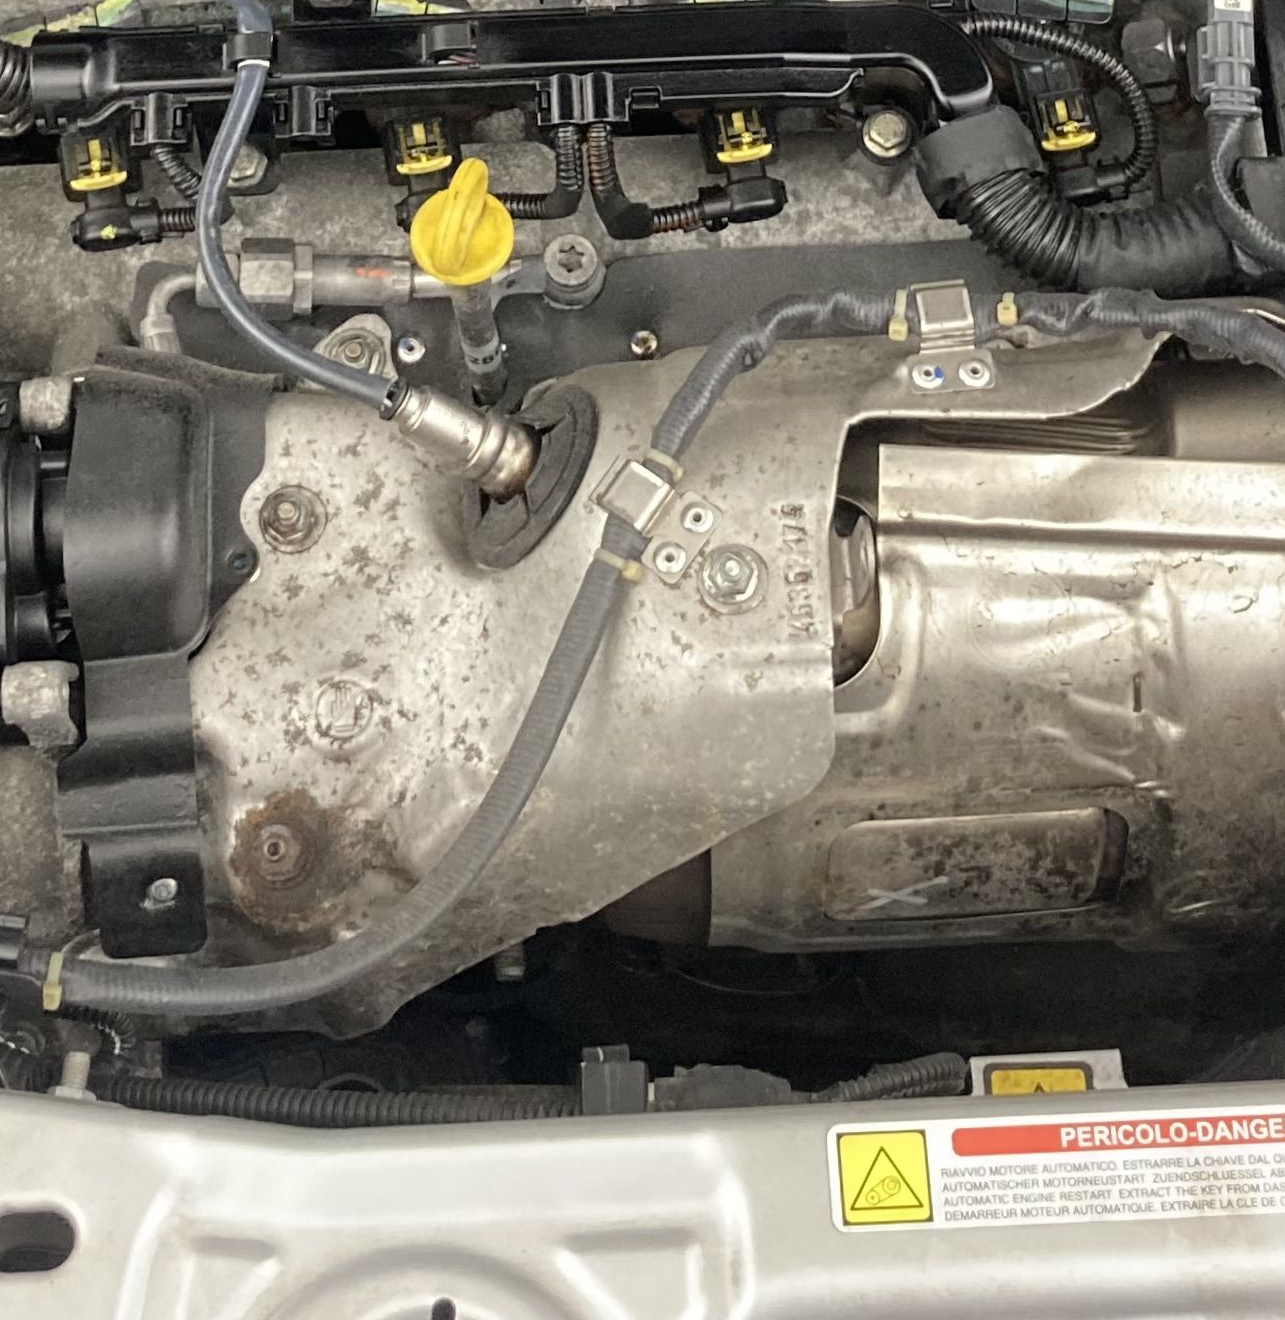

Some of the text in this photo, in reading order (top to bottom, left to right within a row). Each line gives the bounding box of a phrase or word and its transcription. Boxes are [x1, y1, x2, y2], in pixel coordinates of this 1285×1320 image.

[941, 1166, 986, 1179] RIAVVIO
[989, 1164, 1038, 1177] MOTORE
[1123, 1158, 1184, 1172] ESTRARRE
[1186, 1156, 1200, 1168] LA
[1204, 1154, 1245, 1168] CHIAVE
[1248, 1152, 1271, 1165] DAL
[942, 1178, 1039, 1193] AUTOMATISCHER
[1152, 1168, 1266, 1184] ZUENDSCHLUESSEL
[943, 1192, 1010, 1207] AUTOMATIC
[1013, 1190, 1057, 1205] ENGINE
[1119, 1186, 1170, 1200] EXTRACT
[1175, 1184, 1197, 1196] THE
[1201, 1183, 1222, 1195] KEY
[1226, 1182, 1260, 1195] FROM
[944, 1207, 1017, 1222] DEMARREUR
[1020, 1204, 1070, 1219] MOTEUR
[1161, 1198, 1216, 1213] EXTRAIRE
[1219, 1197, 1234, 1209] LA
[1236, 1196, 1259, 1209] CLE
[1261, 1195, 1277, 1207] DE
